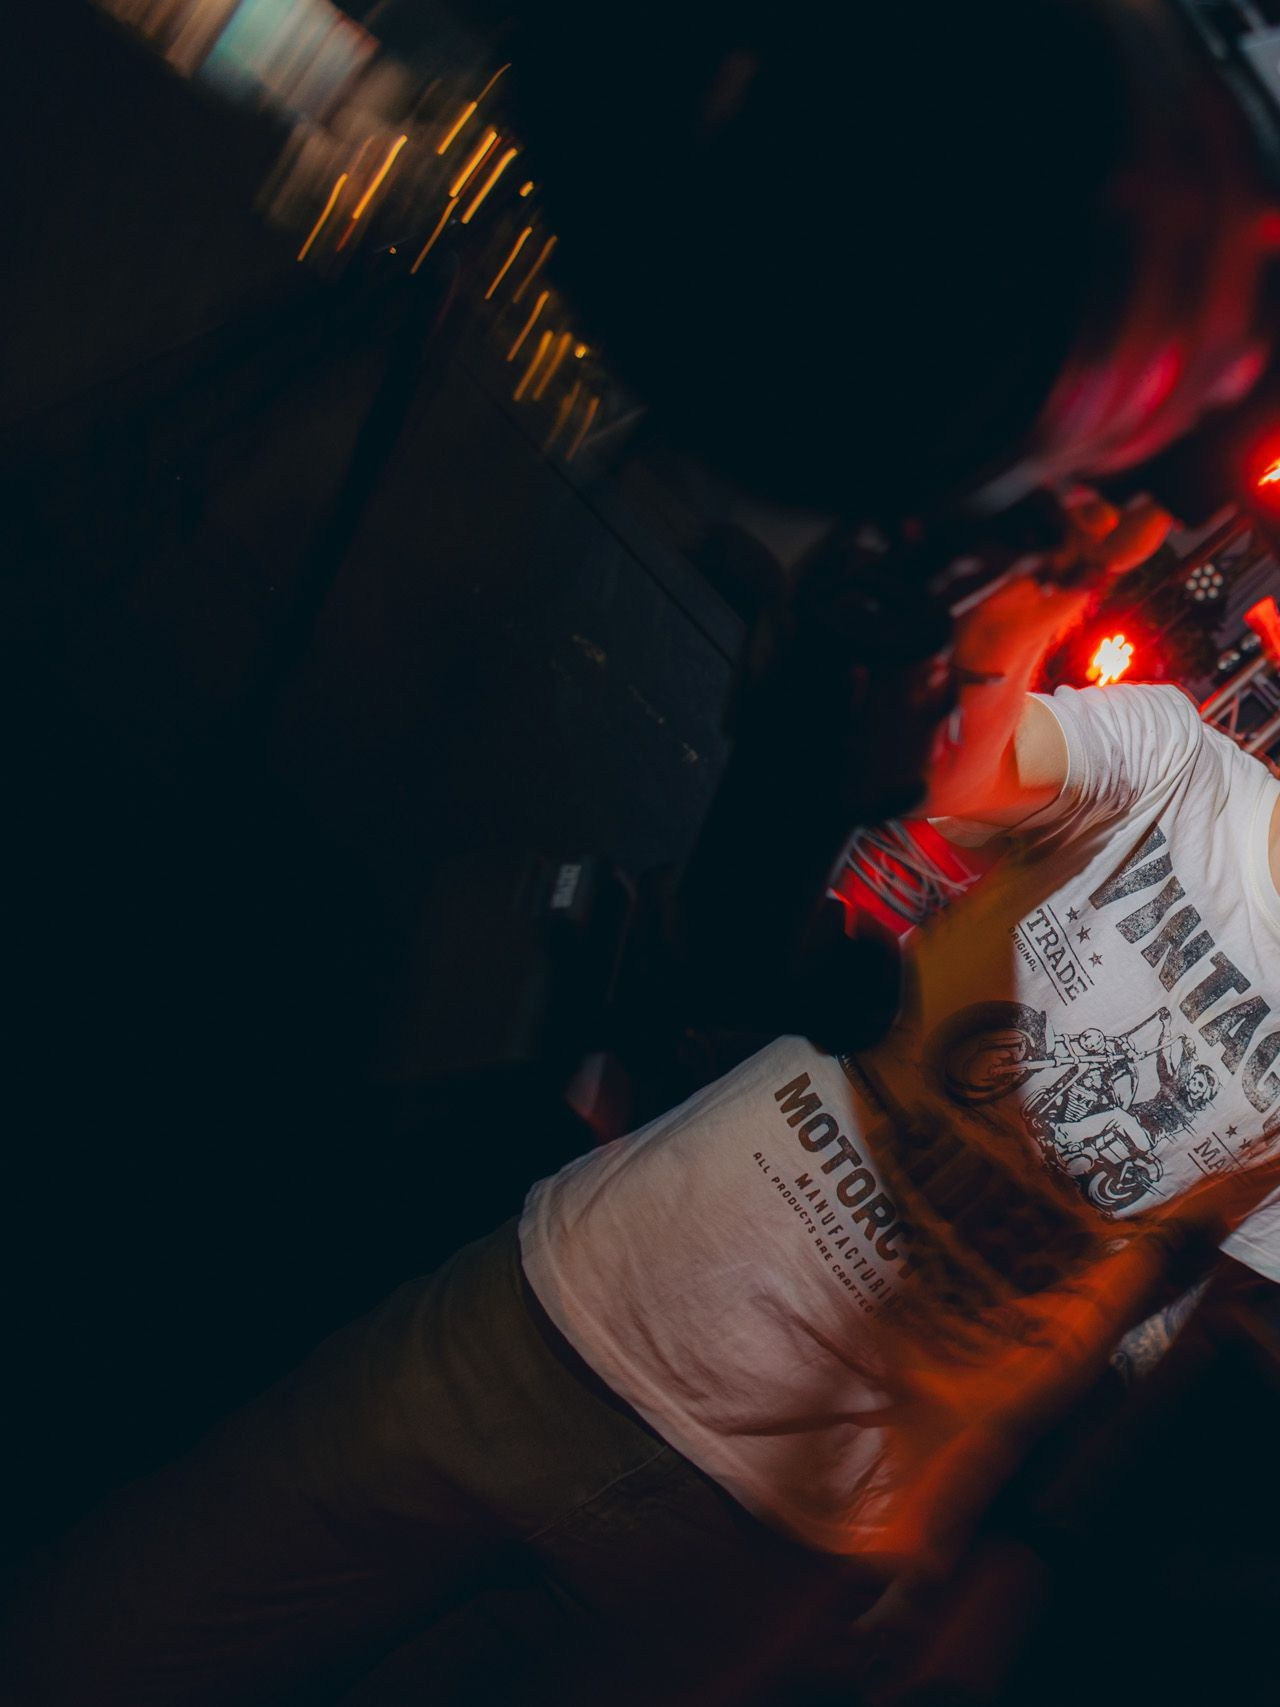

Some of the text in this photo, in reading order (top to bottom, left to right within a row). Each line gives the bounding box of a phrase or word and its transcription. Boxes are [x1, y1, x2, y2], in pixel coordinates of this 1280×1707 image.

[1010, 926, 1038, 973] ORIGINAL
[1026, 908, 1088, 1001] TRADE
[753, 1152, 773, 1174] ALL
[771, 1177, 816, 1234] PRODUCTS
[814, 1238, 833, 1262] ARE
[795, 1173, 903, 1310] MANUFACTURIN
